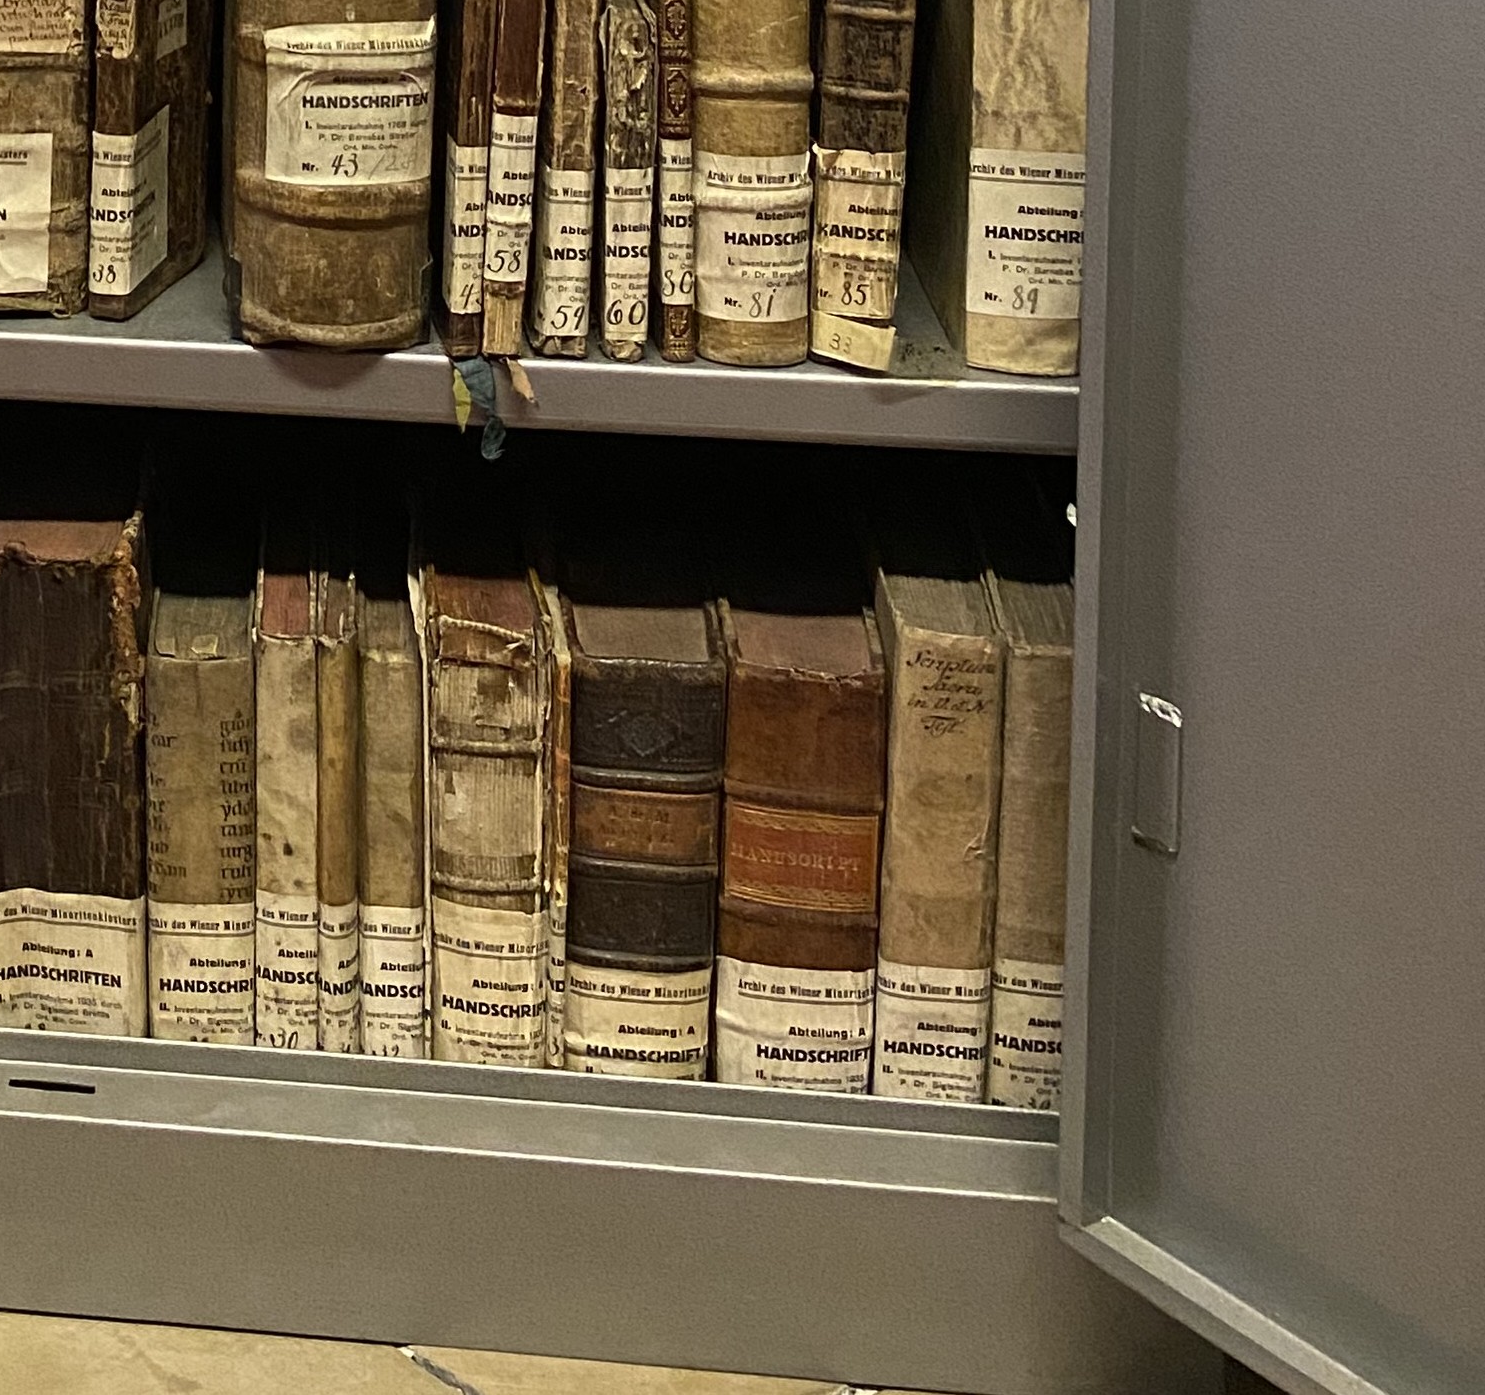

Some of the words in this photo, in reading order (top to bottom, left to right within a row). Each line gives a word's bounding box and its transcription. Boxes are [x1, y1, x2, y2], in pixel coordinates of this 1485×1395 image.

[336, 41, 365, 50] Wiener
[303, 92, 429, 108] HANDSCHRIFTEN
[507, 132, 533, 143] Wiener
[103, 152, 132, 162] Wiener
[302, 162, 319, 171] Nr.
[331, 154, 359, 177] 43
[1019, 166, 1051, 178] Wiener
[708, 170, 734, 184] Archiv
[756, 174, 786, 184] Wiener
[851, 167, 881, 179] Wiener
[614, 186, 643, 196] Wiener
[1017, 205, 1084, 219] Abteilung:
[487, 250, 521, 273] 58
[93, 264, 116, 284] 38
[724, 297, 742, 307] Nr.
[841, 284, 870, 306] 85
[985, 292, 1002, 302] Nr.
[1012, 285, 1039, 314] 89
[551, 305, 585, 330] 59
[607, 300, 646, 325] 60
[4, 909, 17, 918] des
[21, 905, 48, 917] Wiener
[51, 909, 137, 927] Minoritenklosters
[279, 910, 309, 922] Wiener
[189, 919, 220, 931] Wiener
[381, 923, 412, 935] Wiener
[22, 942, 81, 958] Abteilung:
[86, 949, 94, 958] A
[474, 941, 504, 953] Wiener
[189, 958, 251, 969] Abteilung:
[472, 978, 534, 992] Abteilung:
[570, 976, 597, 991] Archiv
[600, 982, 615, 993] des
[620, 982, 651, 996] Wiener
[738, 979, 767, 992] Archiv
[771, 985, 785, 994] des
[789, 986, 821, 997] Wiener
[900, 982, 916, 992] des
[920, 984, 951, 995] Wiener
[1011, 977, 1027, 987] des
[1031, 979, 1063, 990] Wiener
[618, 1024, 682, 1038] Abteilung:
[687, 1026, 695, 1034] A
[789, 1026, 853, 1039] Abteilung:
[858, 1028, 866, 1036] A
[917, 1022, 982, 1036] Abteilung:
[269, 1028, 299, 1050] 30
